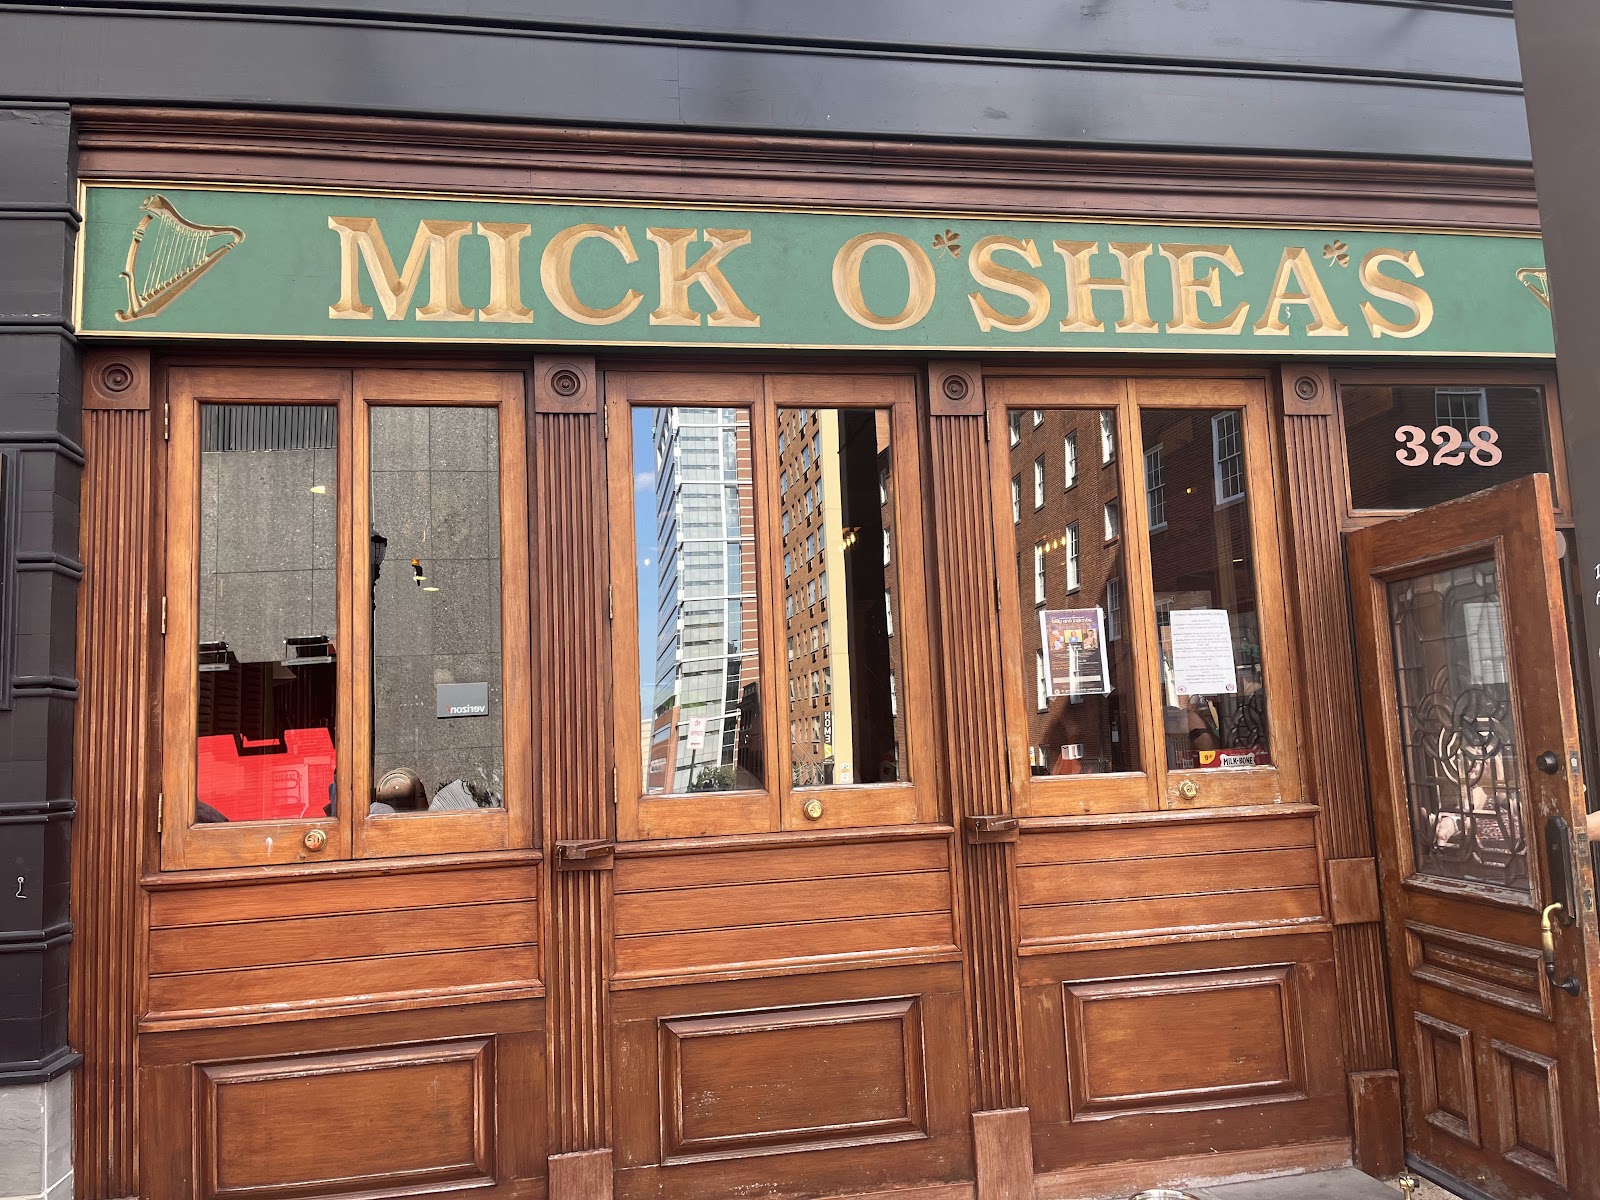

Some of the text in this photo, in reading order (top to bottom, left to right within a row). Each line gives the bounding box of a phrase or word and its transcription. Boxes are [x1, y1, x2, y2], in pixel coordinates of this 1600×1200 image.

[327, 215, 1435, 339] MICK O'SHEA'S
[1394, 425, 1503, 467] 328
